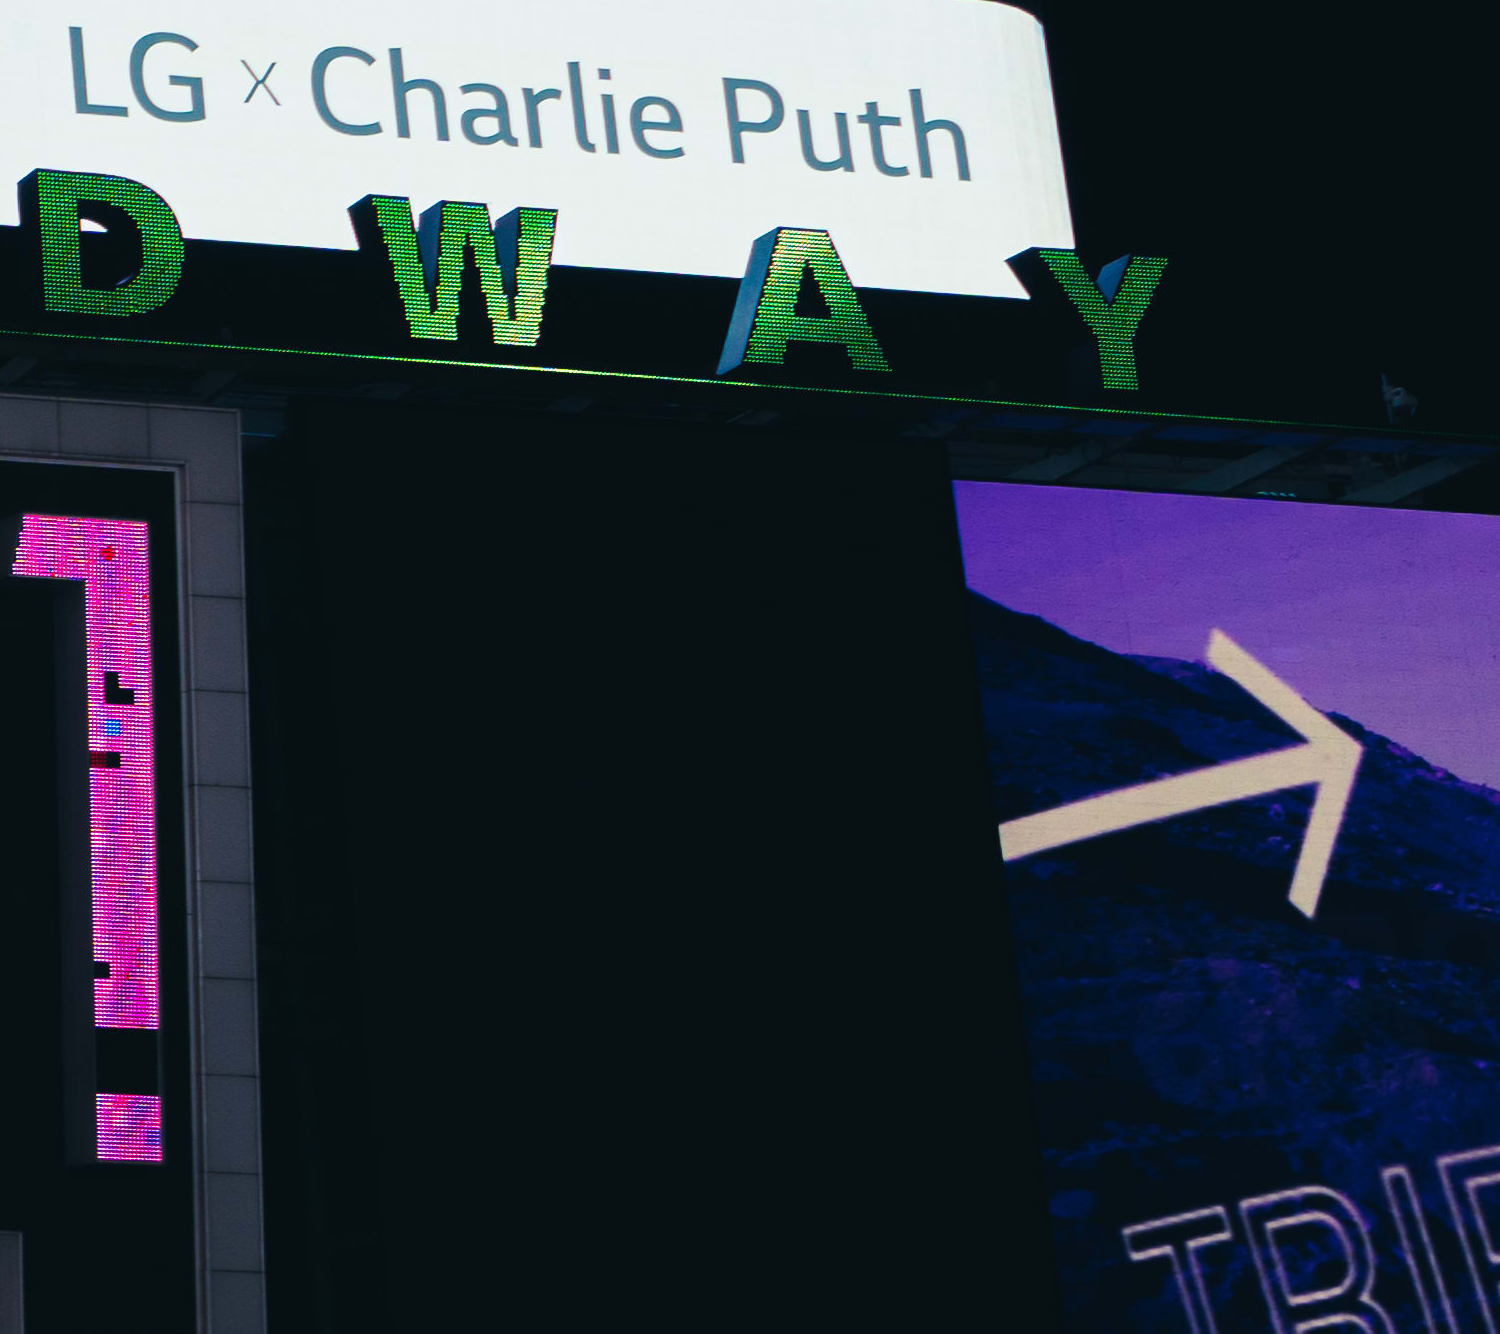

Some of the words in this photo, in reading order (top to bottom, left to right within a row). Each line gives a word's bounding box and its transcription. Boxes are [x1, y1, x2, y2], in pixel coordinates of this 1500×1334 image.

[66, 25, 208, 124] LG
[309, 45, 687, 161] Charlie
[720, 76, 973, 182] Puth
